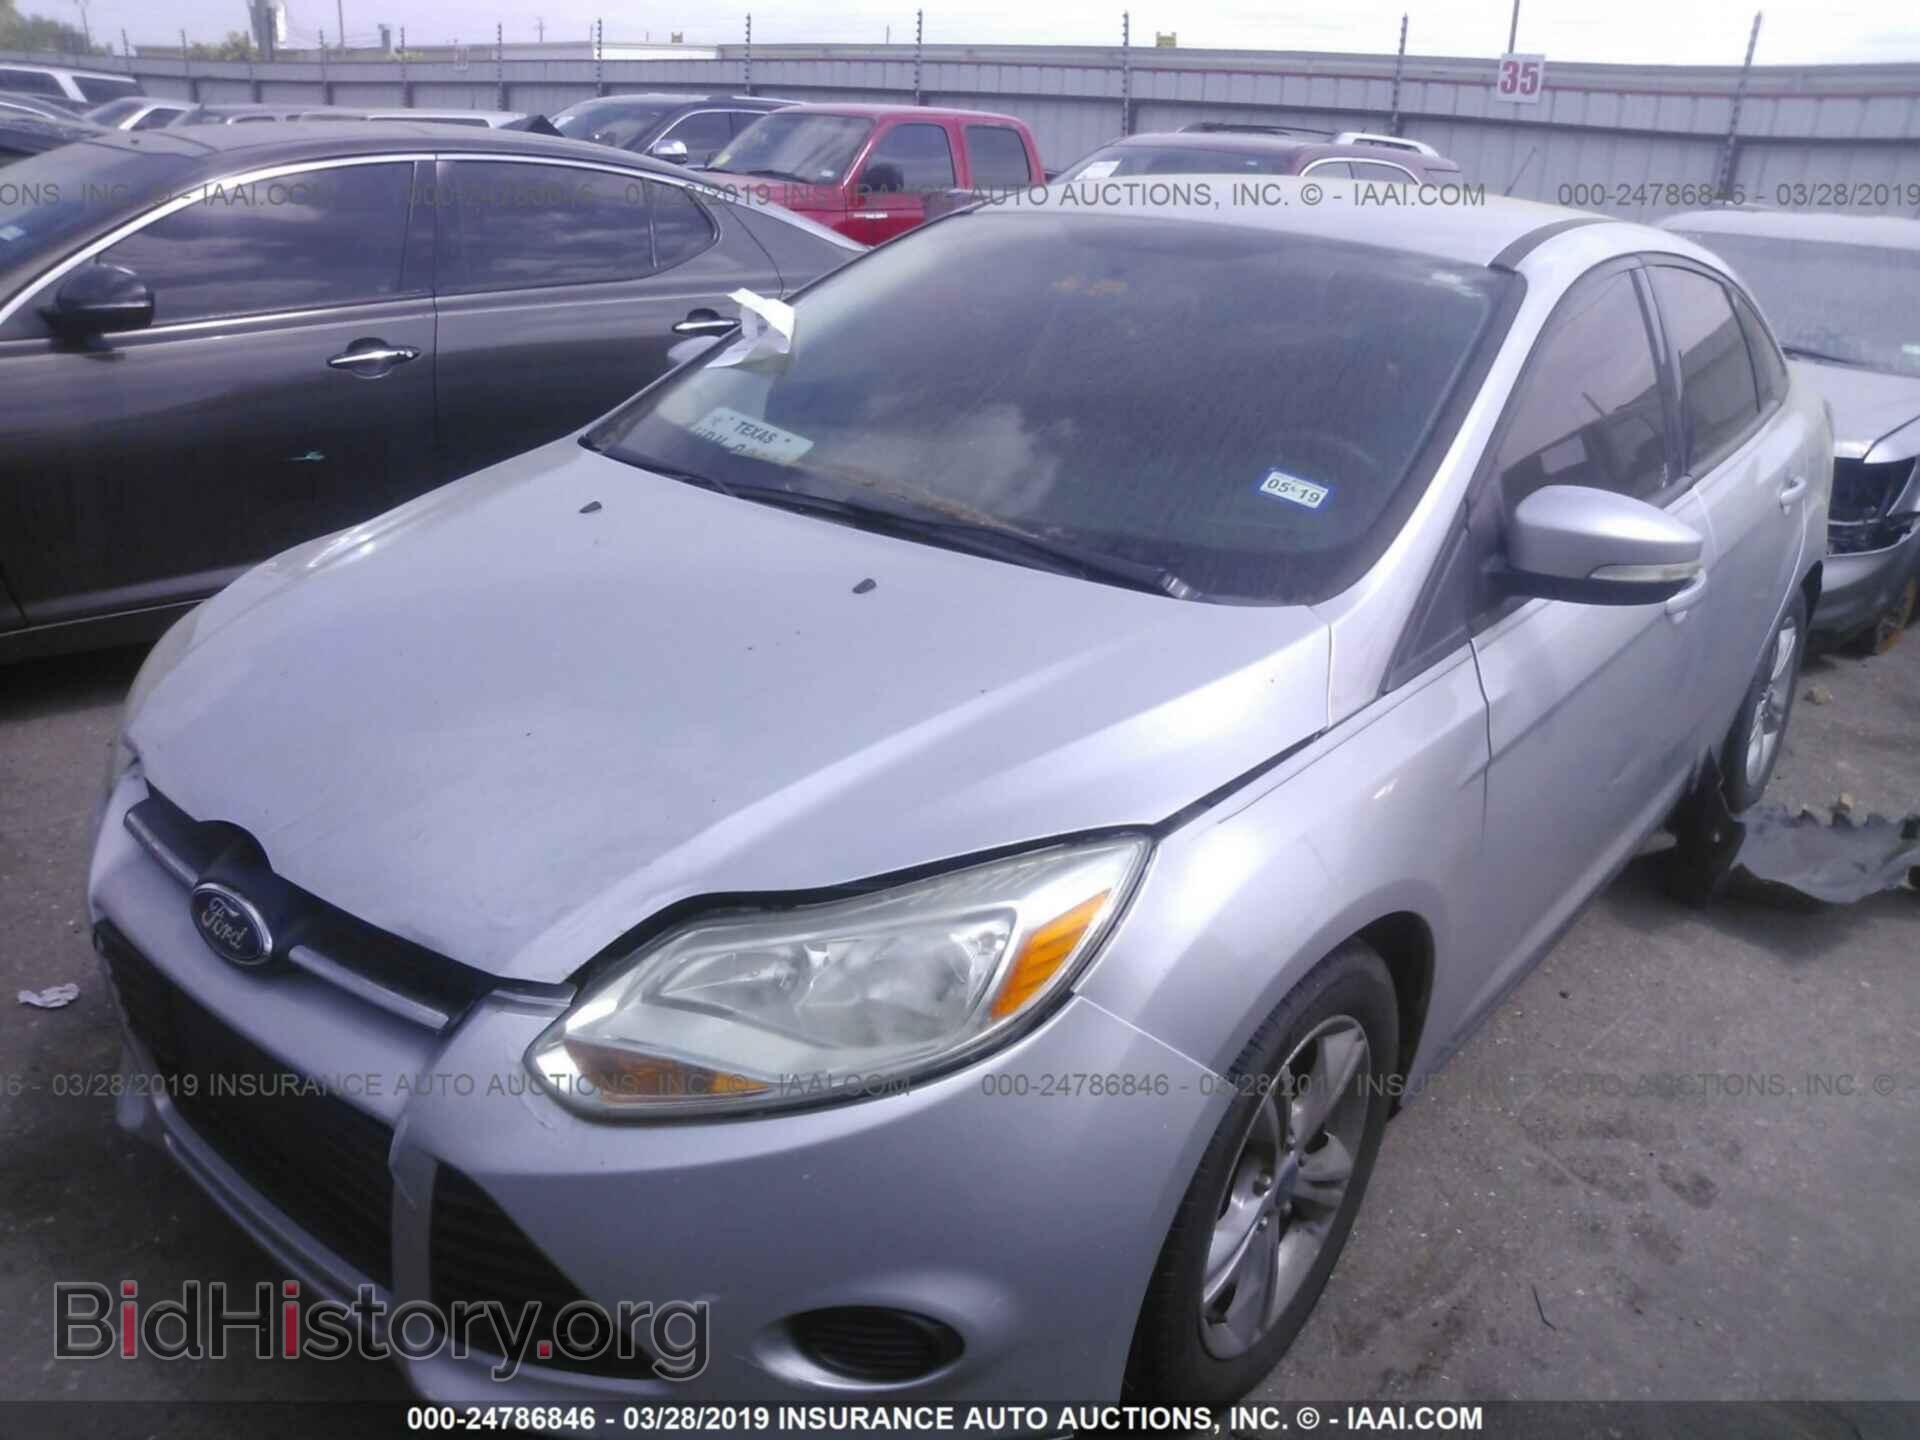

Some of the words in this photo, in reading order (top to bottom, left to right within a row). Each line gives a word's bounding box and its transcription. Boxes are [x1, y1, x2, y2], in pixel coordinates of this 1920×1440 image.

[1501, 61, 1539, 96] 35
[733, 421, 777, 444] TEXAS
[202, 897, 249, 949] Ford
